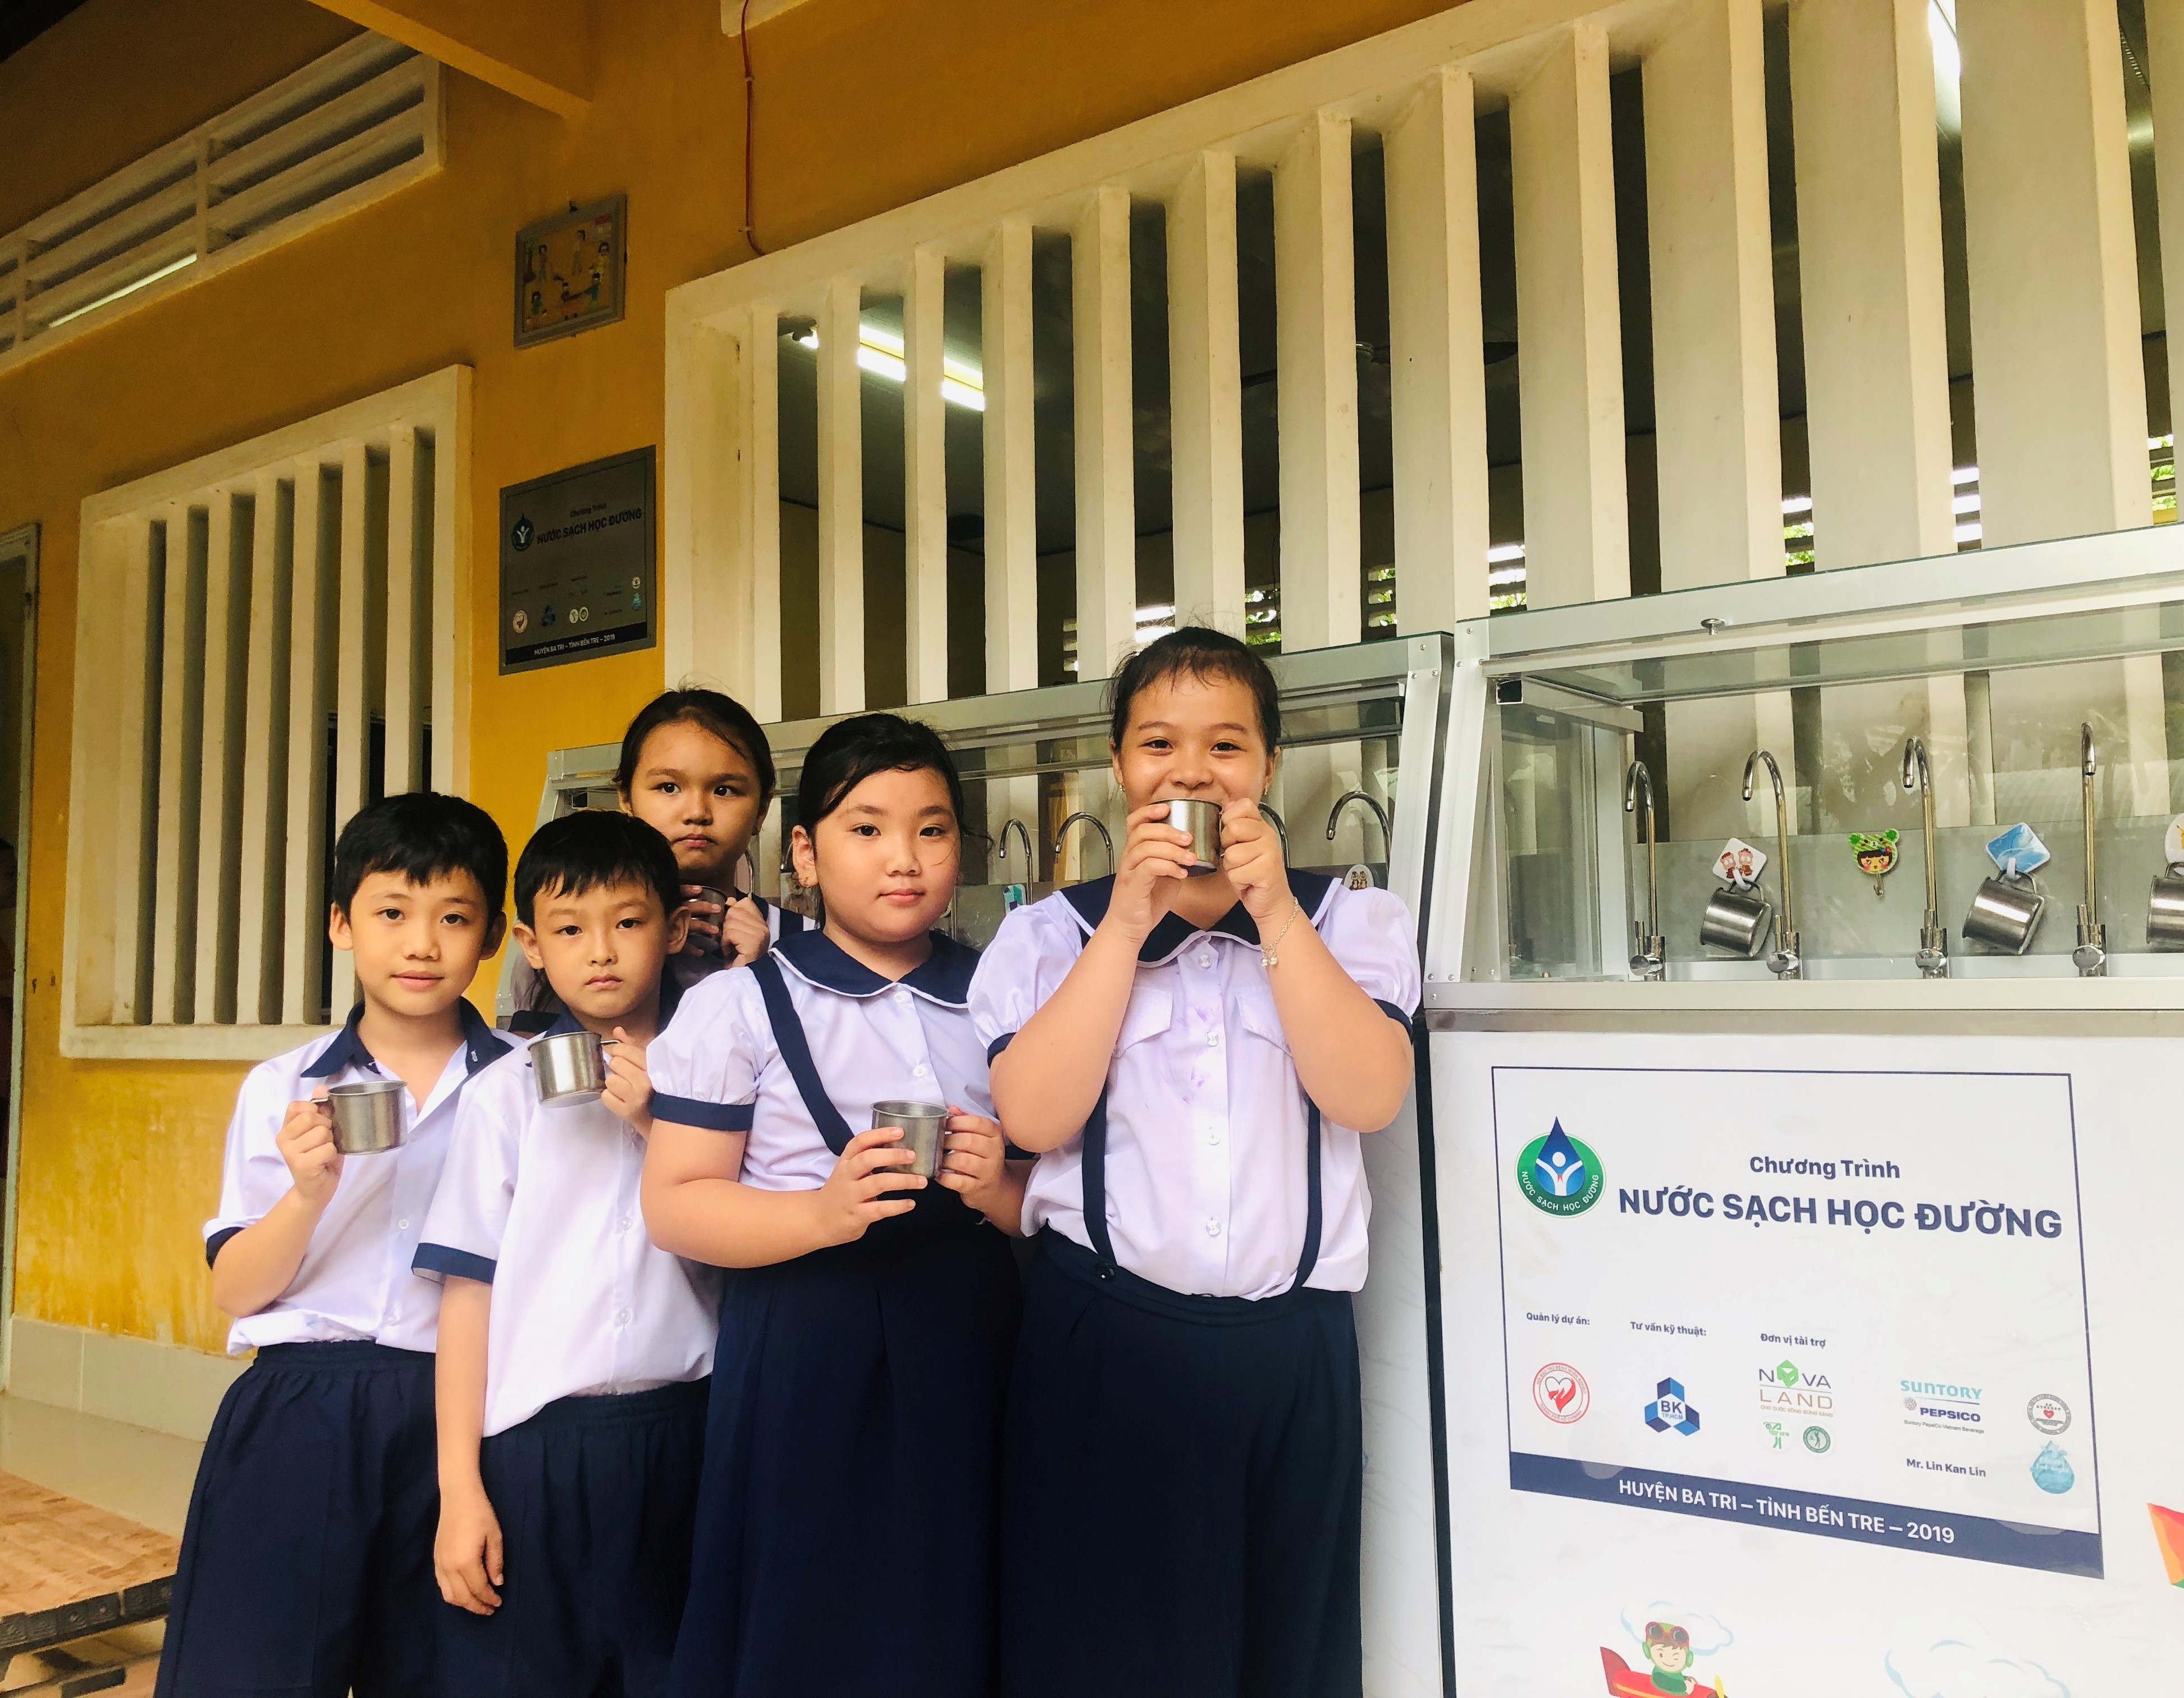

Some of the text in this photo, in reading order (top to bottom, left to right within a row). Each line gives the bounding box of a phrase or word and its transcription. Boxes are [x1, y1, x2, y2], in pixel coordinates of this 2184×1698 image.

[563, 523, 587, 539] SẠCH
[588, 517, 607, 532] HỌC
[1749, 1156, 1900, 1180] Chương Trình
[1522, 1171, 1599, 1212] NƯỚC SẠCH HỌC ĐƯỜNG
[1619, 1185, 2062, 1239] NƯỚC SẠCH HỌC ĐƯỜNG
[1526, 1312, 1590, 1326] Quản lý dự án:
[1630, 1321, 1707, 1337] Tư vấn kỹ thuật:
[1760, 1333, 1826, 1349] Đơn vị tài trợ
[1760, 1389, 1833, 1409] LAND
[1900, 1380, 1983, 1399] SUNTORY
[1661, 1400, 1683, 1414] BK
[1920, 1407, 1981, 1422] PEPSICO
[1906, 1458, 1986, 1477] Mr. Lin Kan Lin
[1619, 1479, 1678, 1503] HUYỆN
[1682, 1489, 1706, 1506] BA
[1708, 1492, 1737, 1510] TRI
[1756, 1496, 1801, 1521] TỈNH
[1806, 1504, 1844, 1527] BẾN
[1847, 1512, 1885, 1533] TRE
[1907, 1522, 1955, 1544] 2019
